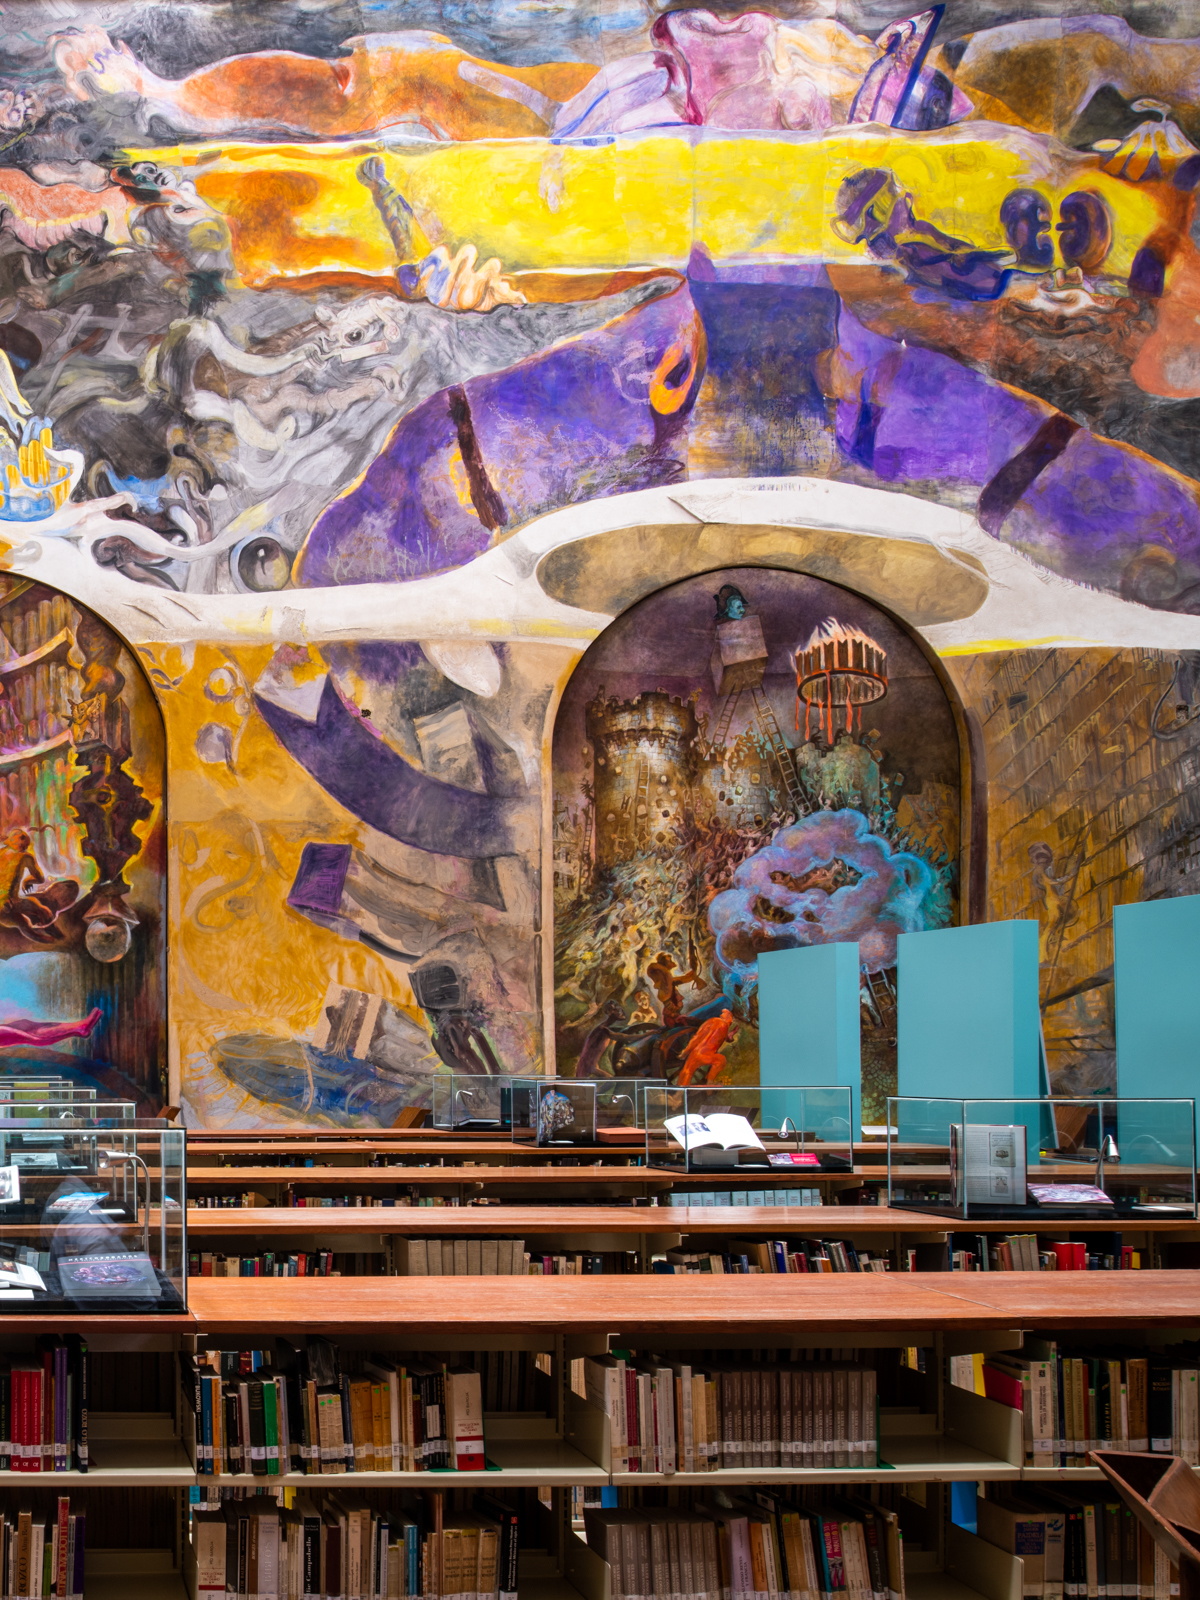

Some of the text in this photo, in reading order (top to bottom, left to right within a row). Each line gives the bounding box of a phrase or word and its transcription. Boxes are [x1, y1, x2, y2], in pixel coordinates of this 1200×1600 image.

[832, 1531, 840, 1552] PARALELO
[19, 1557, 27, 1593] OROZCO
[264, 1542, 272, 1582] BIBLOS
